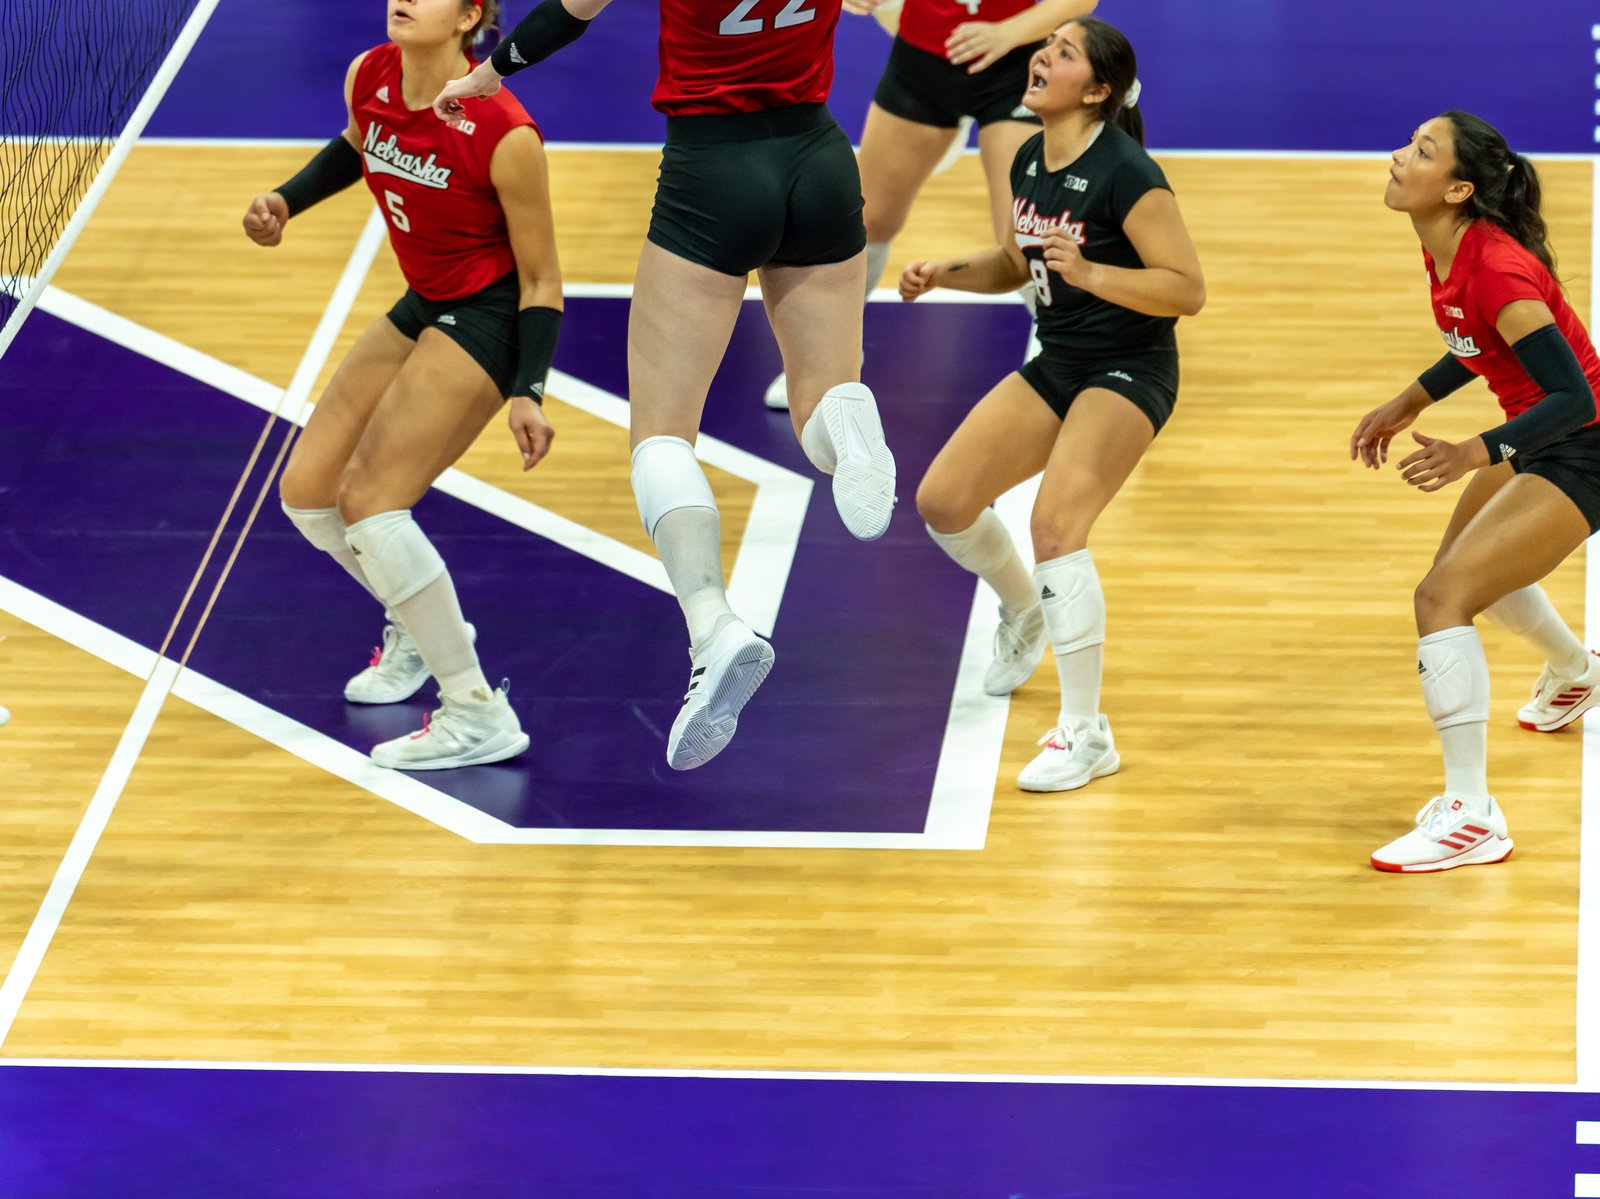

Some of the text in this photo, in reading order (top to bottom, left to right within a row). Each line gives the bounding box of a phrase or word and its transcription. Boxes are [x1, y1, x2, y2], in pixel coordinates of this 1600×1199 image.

[362, 120, 451, 188] Nebraska
[384, 189, 411, 233] 5
[1029, 259, 1052, 307] 8
